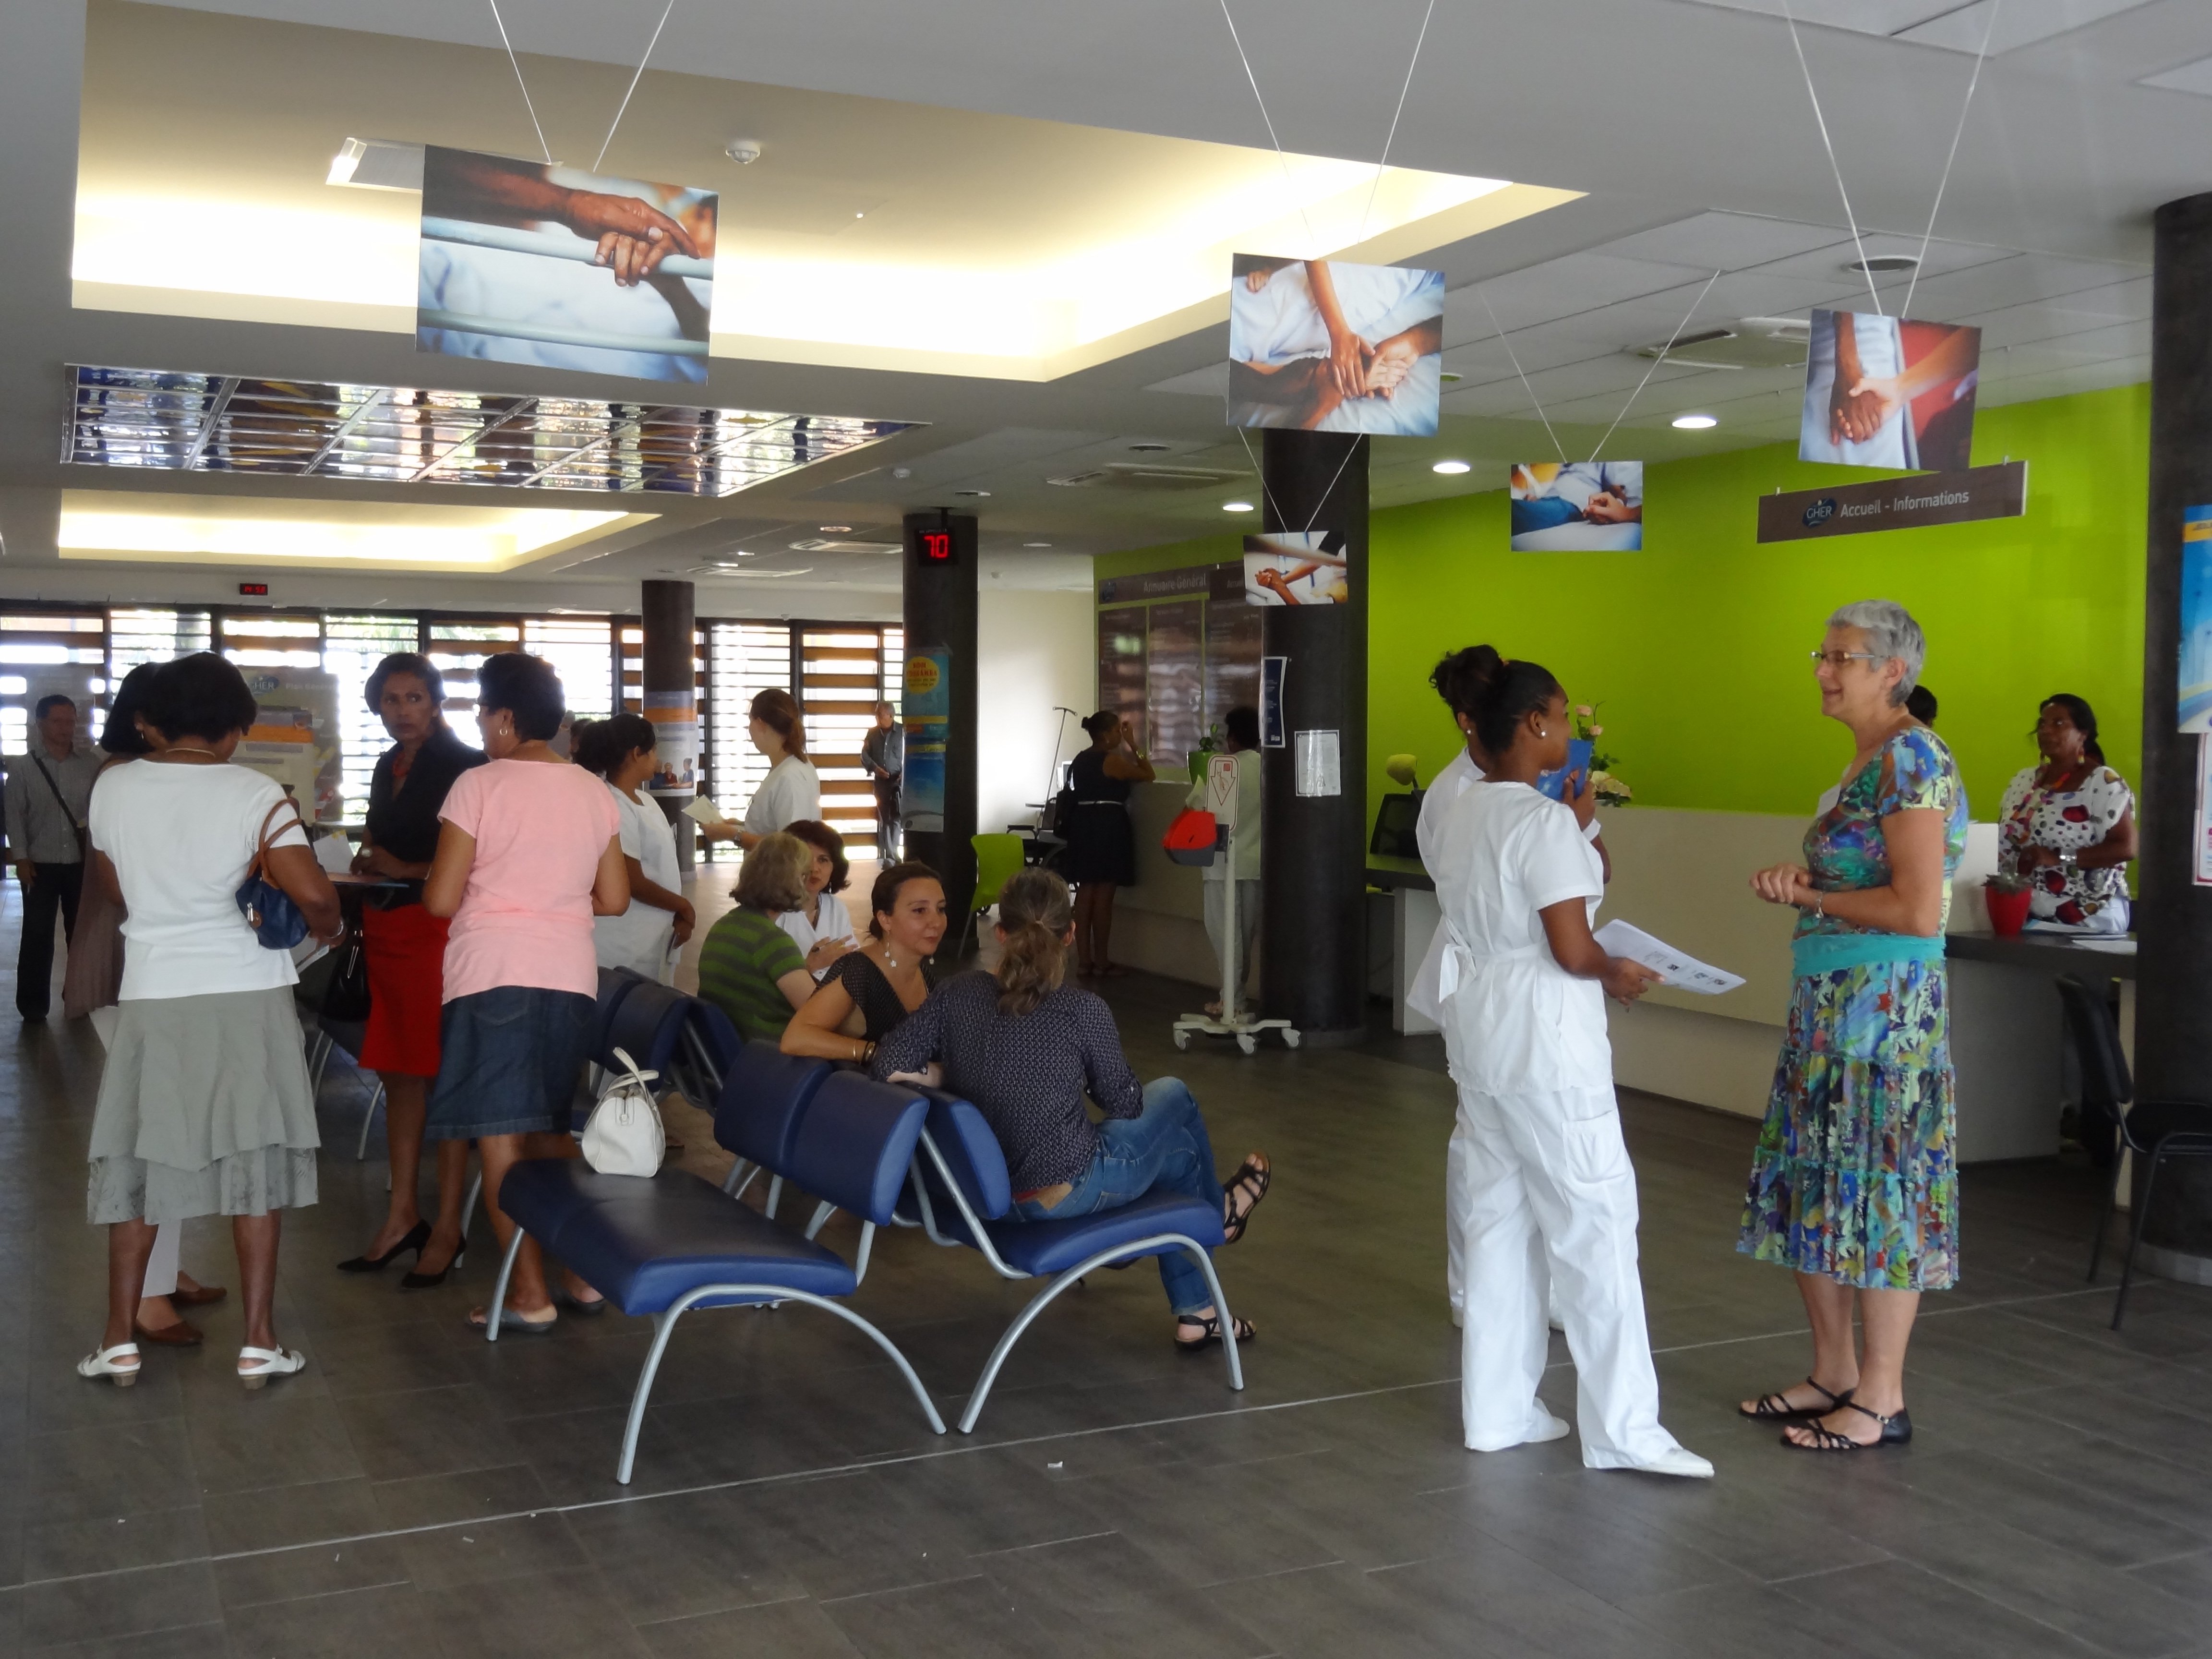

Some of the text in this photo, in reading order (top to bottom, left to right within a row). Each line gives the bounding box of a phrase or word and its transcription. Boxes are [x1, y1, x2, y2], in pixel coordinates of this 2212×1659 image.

[1806, 505, 1832, 519] GHER
[1840, 499, 1881, 518] Accueil
[1894, 490, 1969, 512] Informations
[924, 535, 948, 558] 70
[1143, 573, 1206, 593] Annuaire Général
